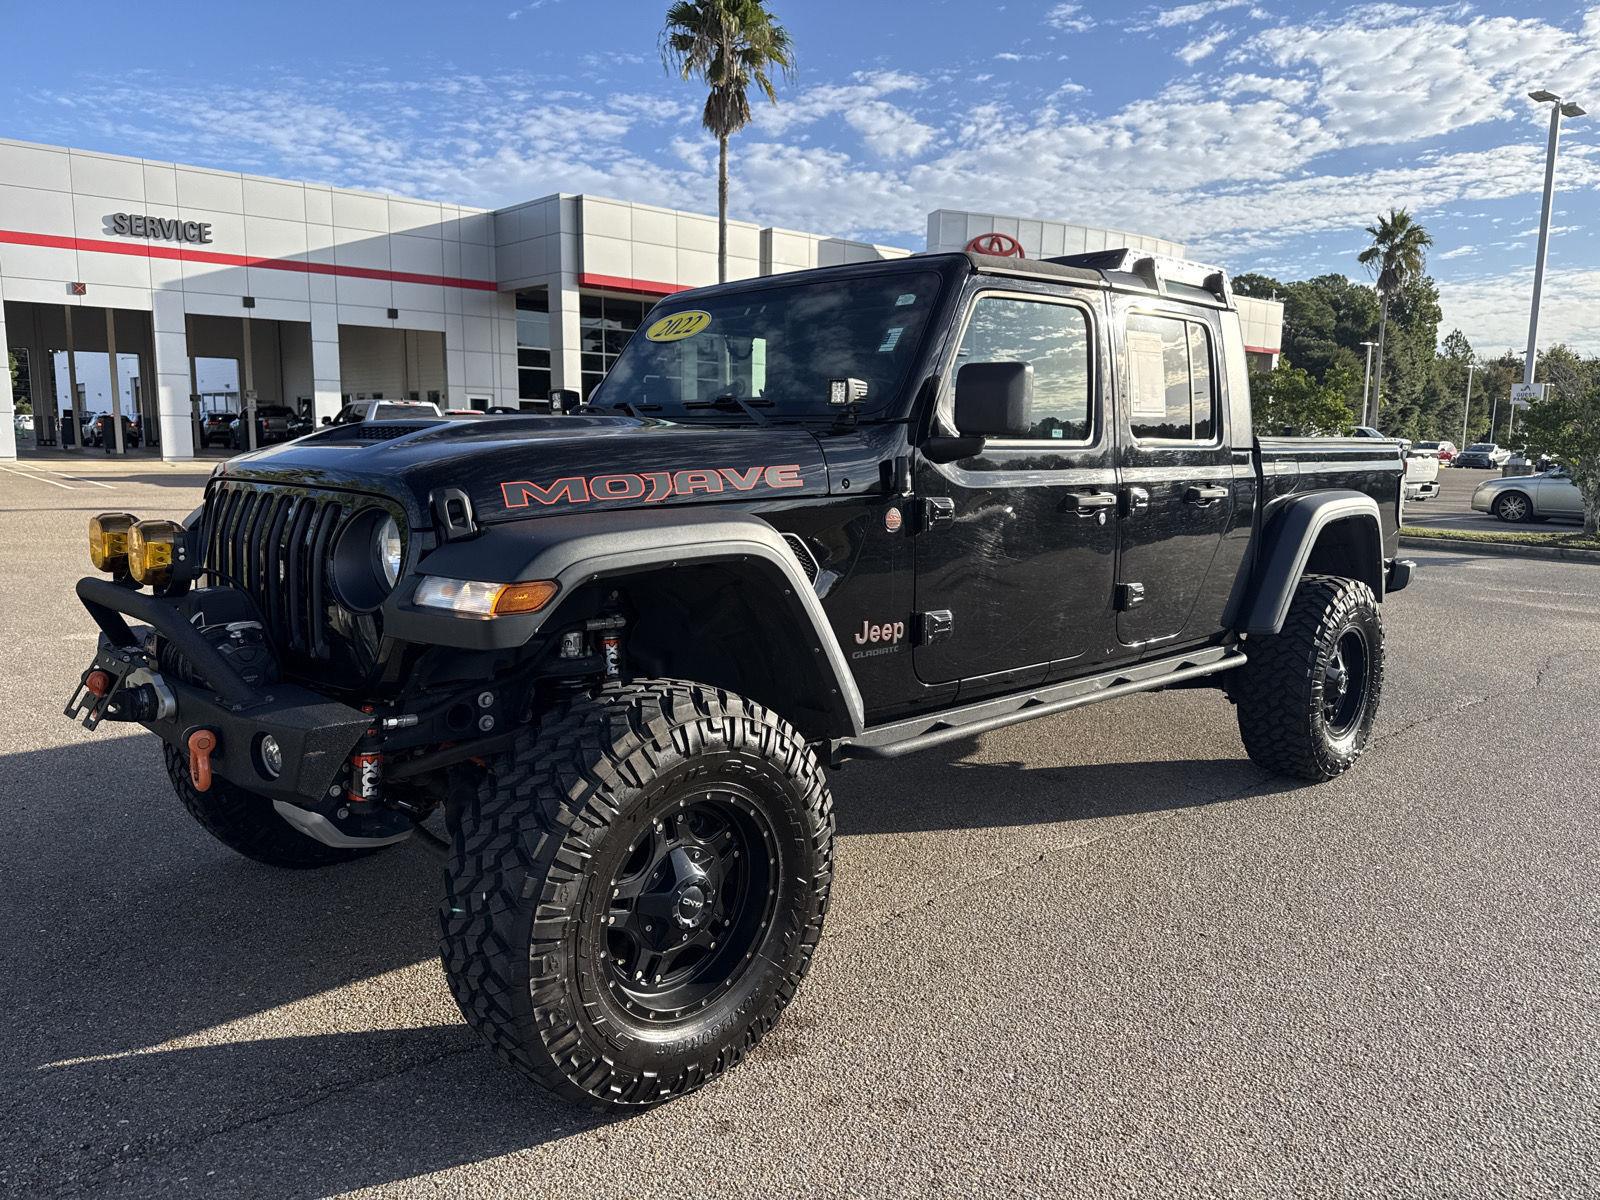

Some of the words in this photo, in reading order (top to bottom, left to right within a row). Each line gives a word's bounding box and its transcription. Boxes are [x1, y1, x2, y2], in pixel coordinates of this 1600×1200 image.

[113, 213, 213, 243] SERVICE
[653, 315, 703, 337] 2022
[500, 465, 803, 508] MOJAVE
[854, 620, 904, 645] Jeep
[605, 643, 619, 676] FOX
[362, 759, 378, 798] FOX
